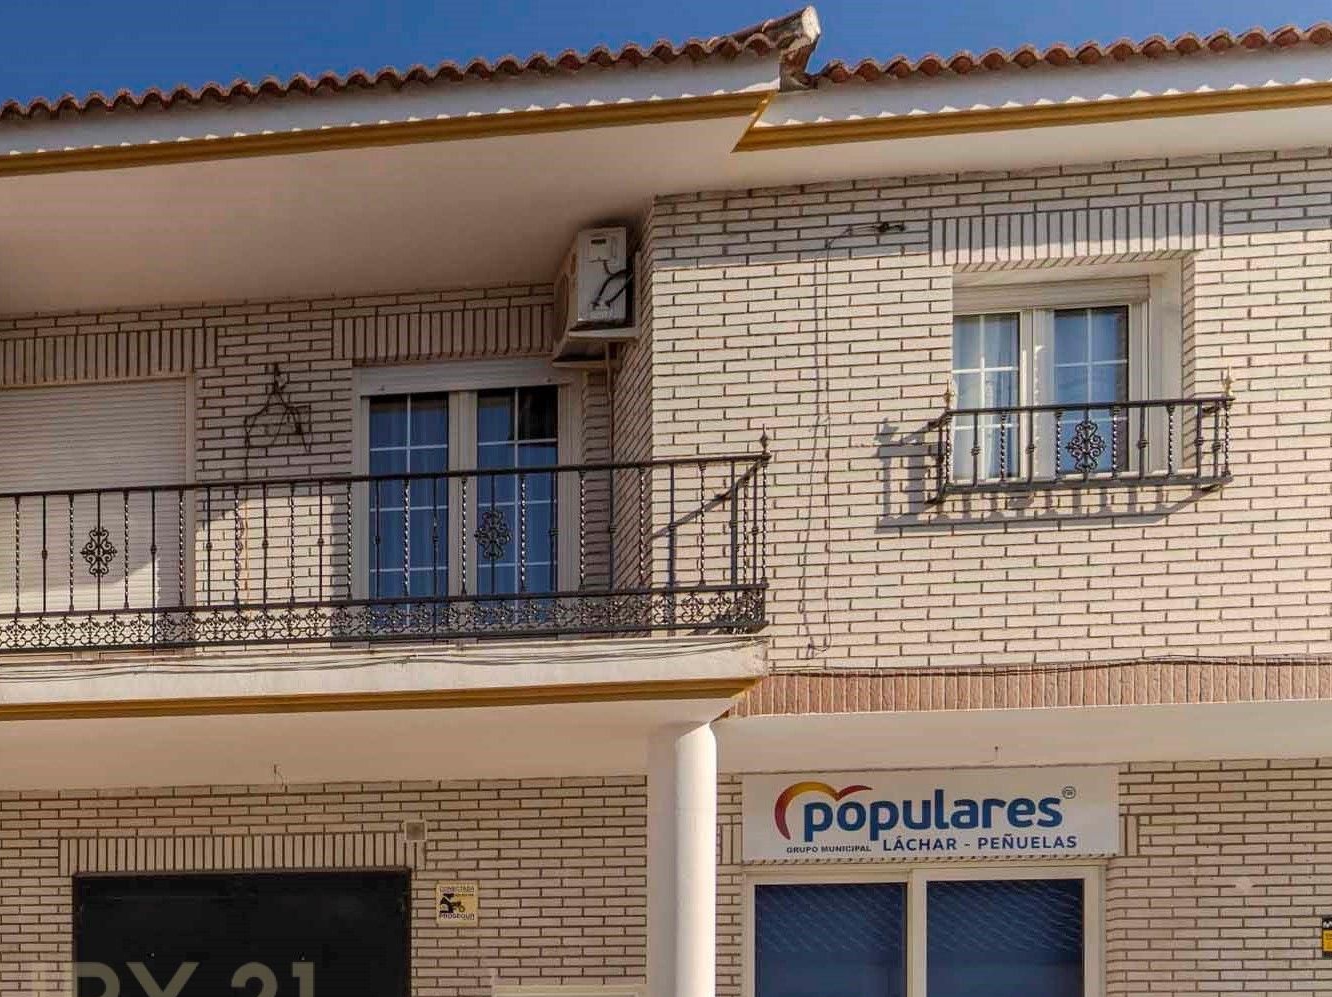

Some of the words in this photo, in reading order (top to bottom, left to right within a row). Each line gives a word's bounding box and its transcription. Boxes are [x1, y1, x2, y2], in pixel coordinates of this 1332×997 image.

[804, 789, 1063, 842] populares
[787, 846, 819, 854] GRUPO
[821, 845, 872, 853] MUNICIPAL
[883, 835, 958, 851] LÁCHAR
[978, 833, 1077, 850] PEÑUELAS
